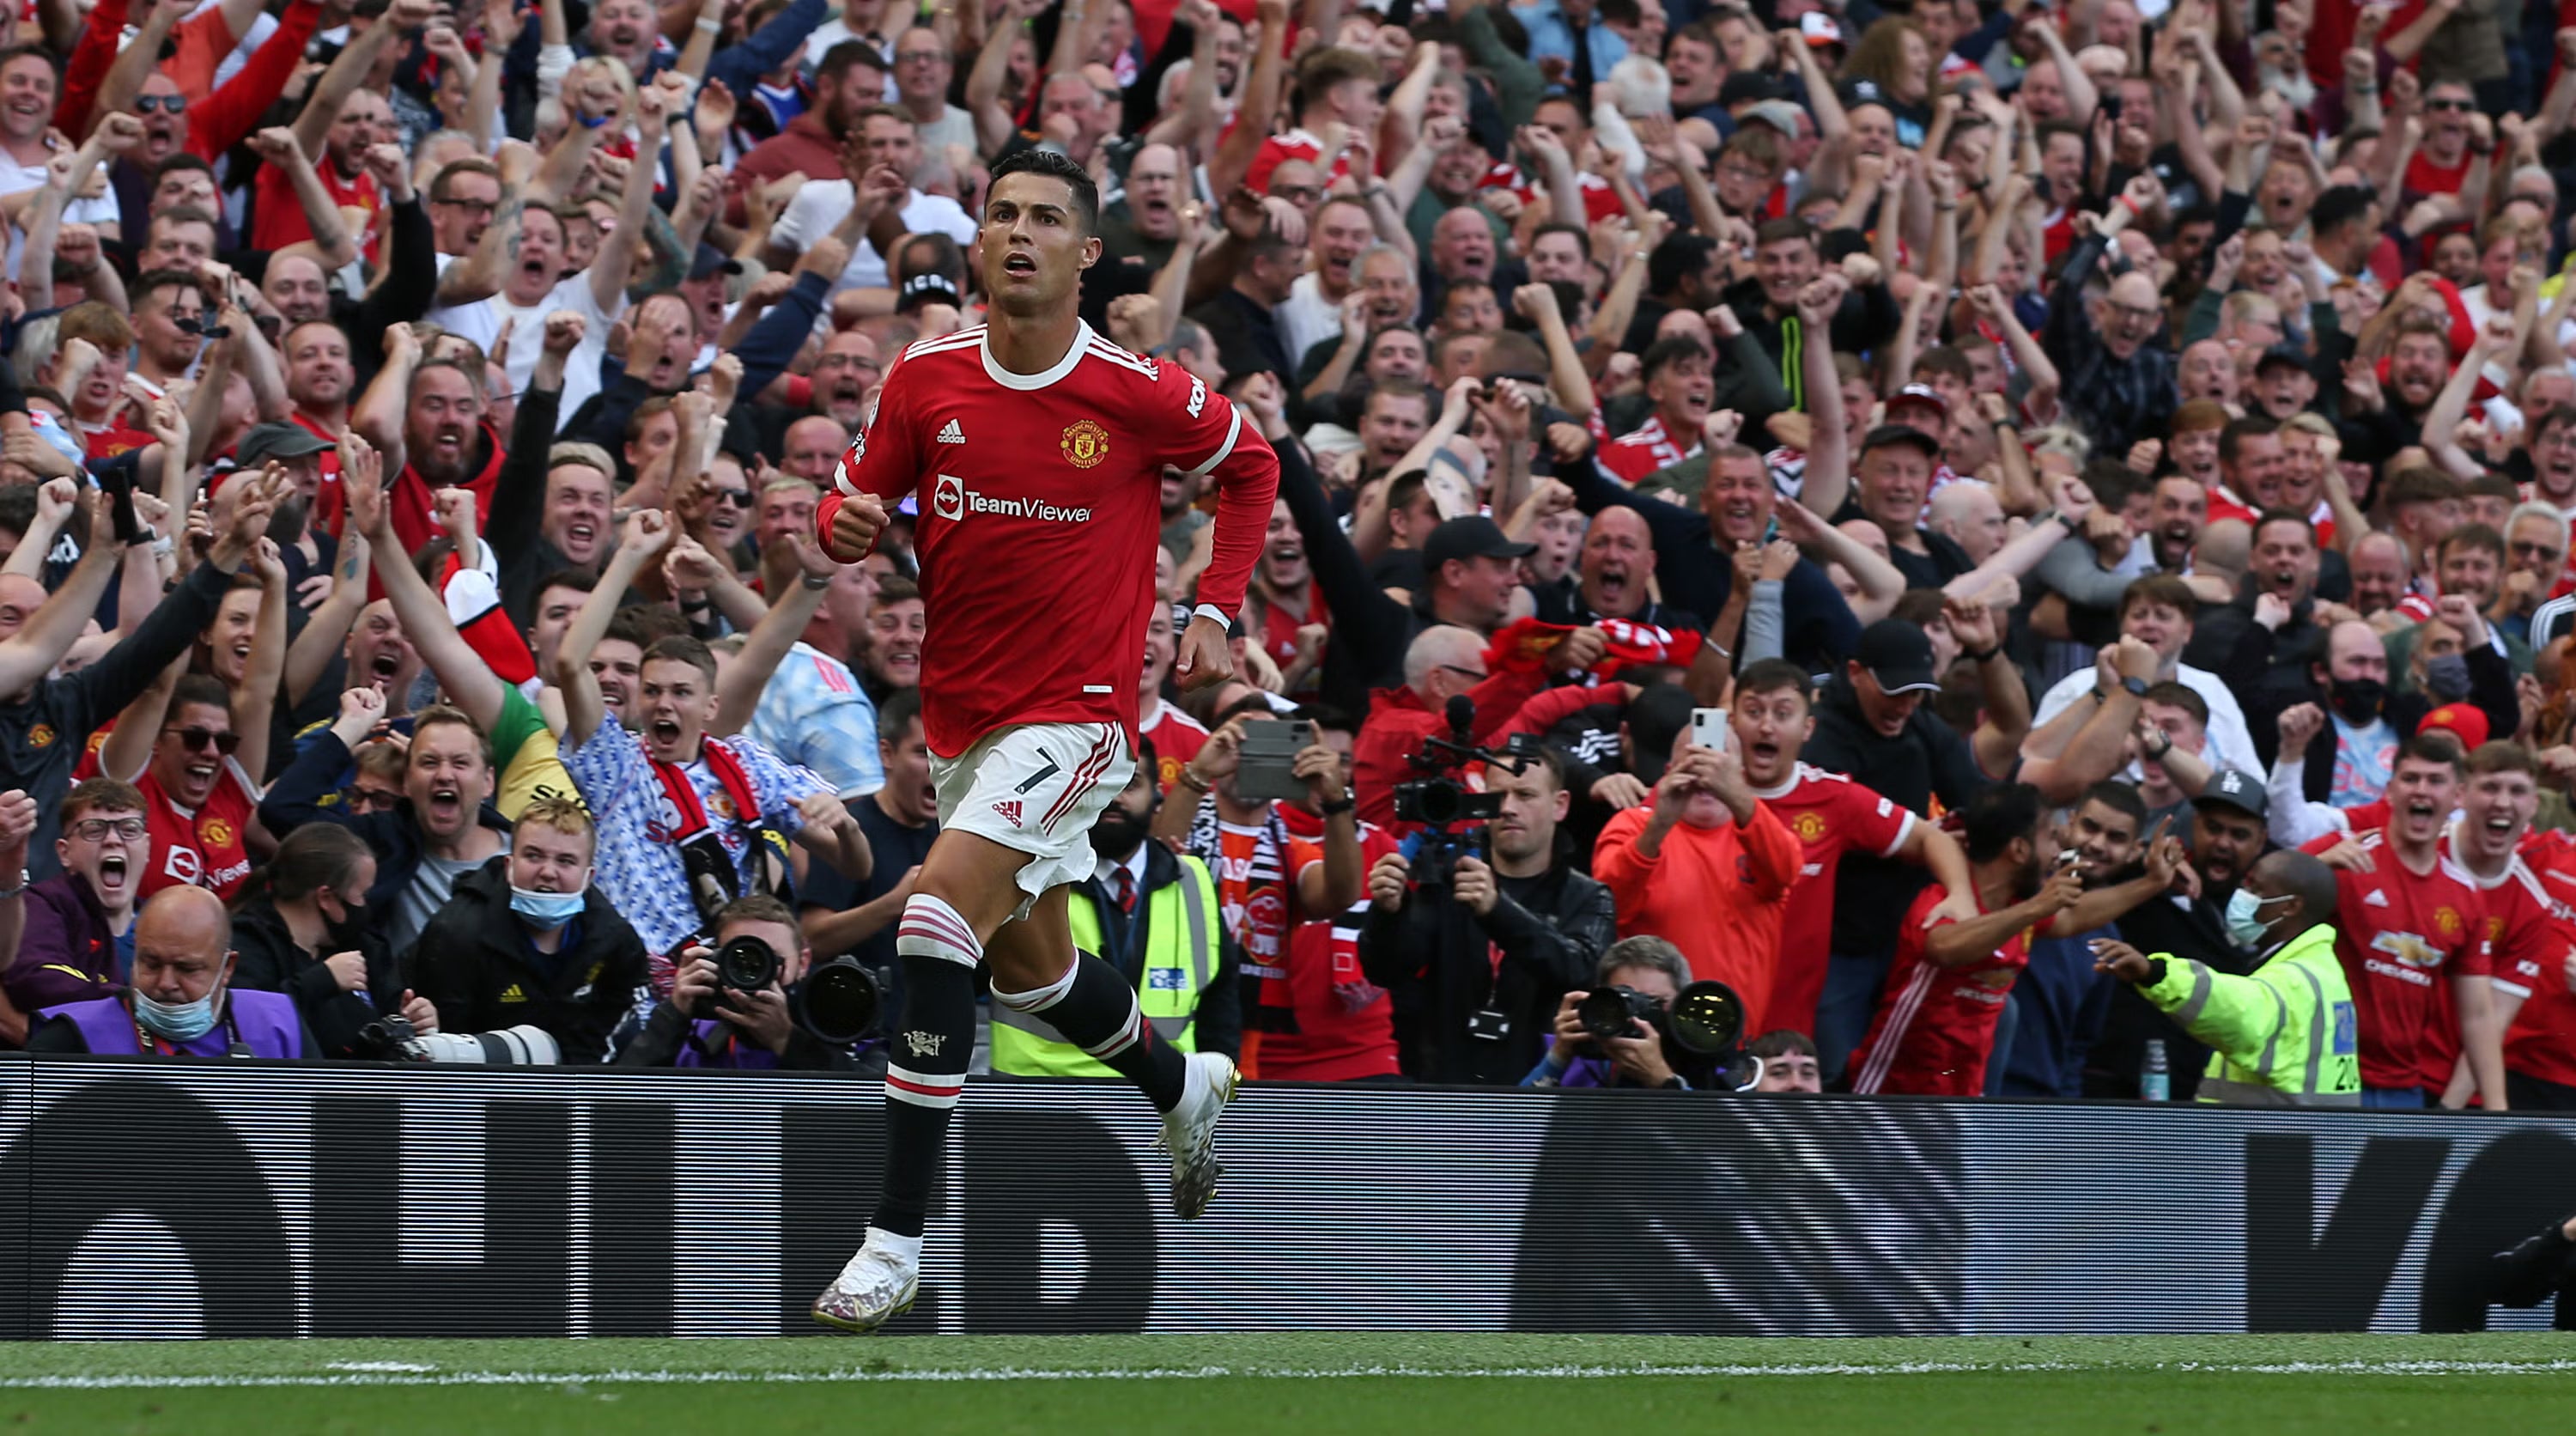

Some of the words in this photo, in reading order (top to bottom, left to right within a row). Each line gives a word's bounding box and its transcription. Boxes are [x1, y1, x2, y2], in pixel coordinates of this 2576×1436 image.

[937, 435, 967, 445] adidas
[1070, 455, 1098, 466] UNITED
[965, 490, 1093, 523] TeamViewer
[1012, 746, 1061, 796] 7
[992, 803, 1023, 829] adidas
